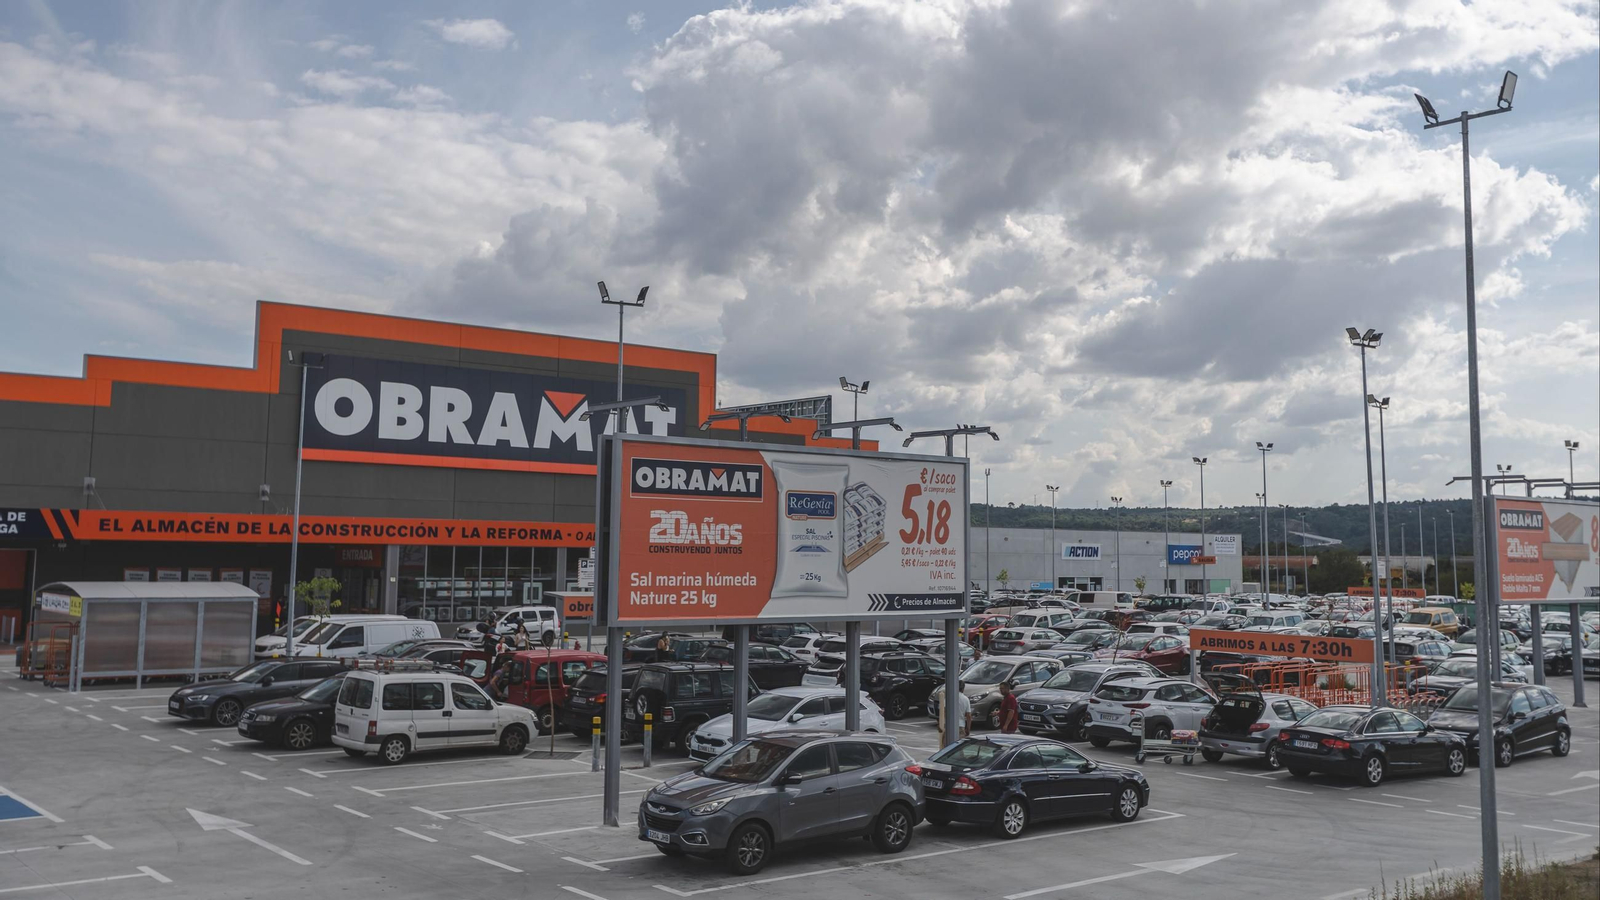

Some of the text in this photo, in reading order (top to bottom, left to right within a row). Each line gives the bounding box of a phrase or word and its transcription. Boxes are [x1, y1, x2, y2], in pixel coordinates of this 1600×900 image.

[635, 466, 759, 493] OBRAMAT
[7, 511, 26, 522] DE
[899, 483, 951, 545] 5,18
[1500, 513, 1542, 528] OBRAMAT
[99, 518, 123, 532] EL
[131, 516, 229, 534] ALMACÉN
[236, 522, 262, 535] DE
[268, 522, 291, 535] LA
[299, 522, 438, 538] CONSTRUCCIÓN
[445, 527, 455, 538] Y
[461, 527, 481, 539] LA
[486, 527, 563, 540] REFORMA
[649, 509, 743, 545] 20 AÑOS
[342, 550, 373, 560] ENTRADA
[648, 545, 742, 554] CONSTRUYENDO JUNTOS
[1069, 546, 1099, 558] ACTION
[1173, 550, 1200, 560] pepco
[630, 572, 757, 586] Sal marina húmeda
[930, 570, 956, 579] IVA inc.
[630, 590, 717, 608] Nature 25 kg
[902, 598, 923, 606] Precios
[1200, 637, 1352, 657] ABRIMOS A LAS 7:30h
